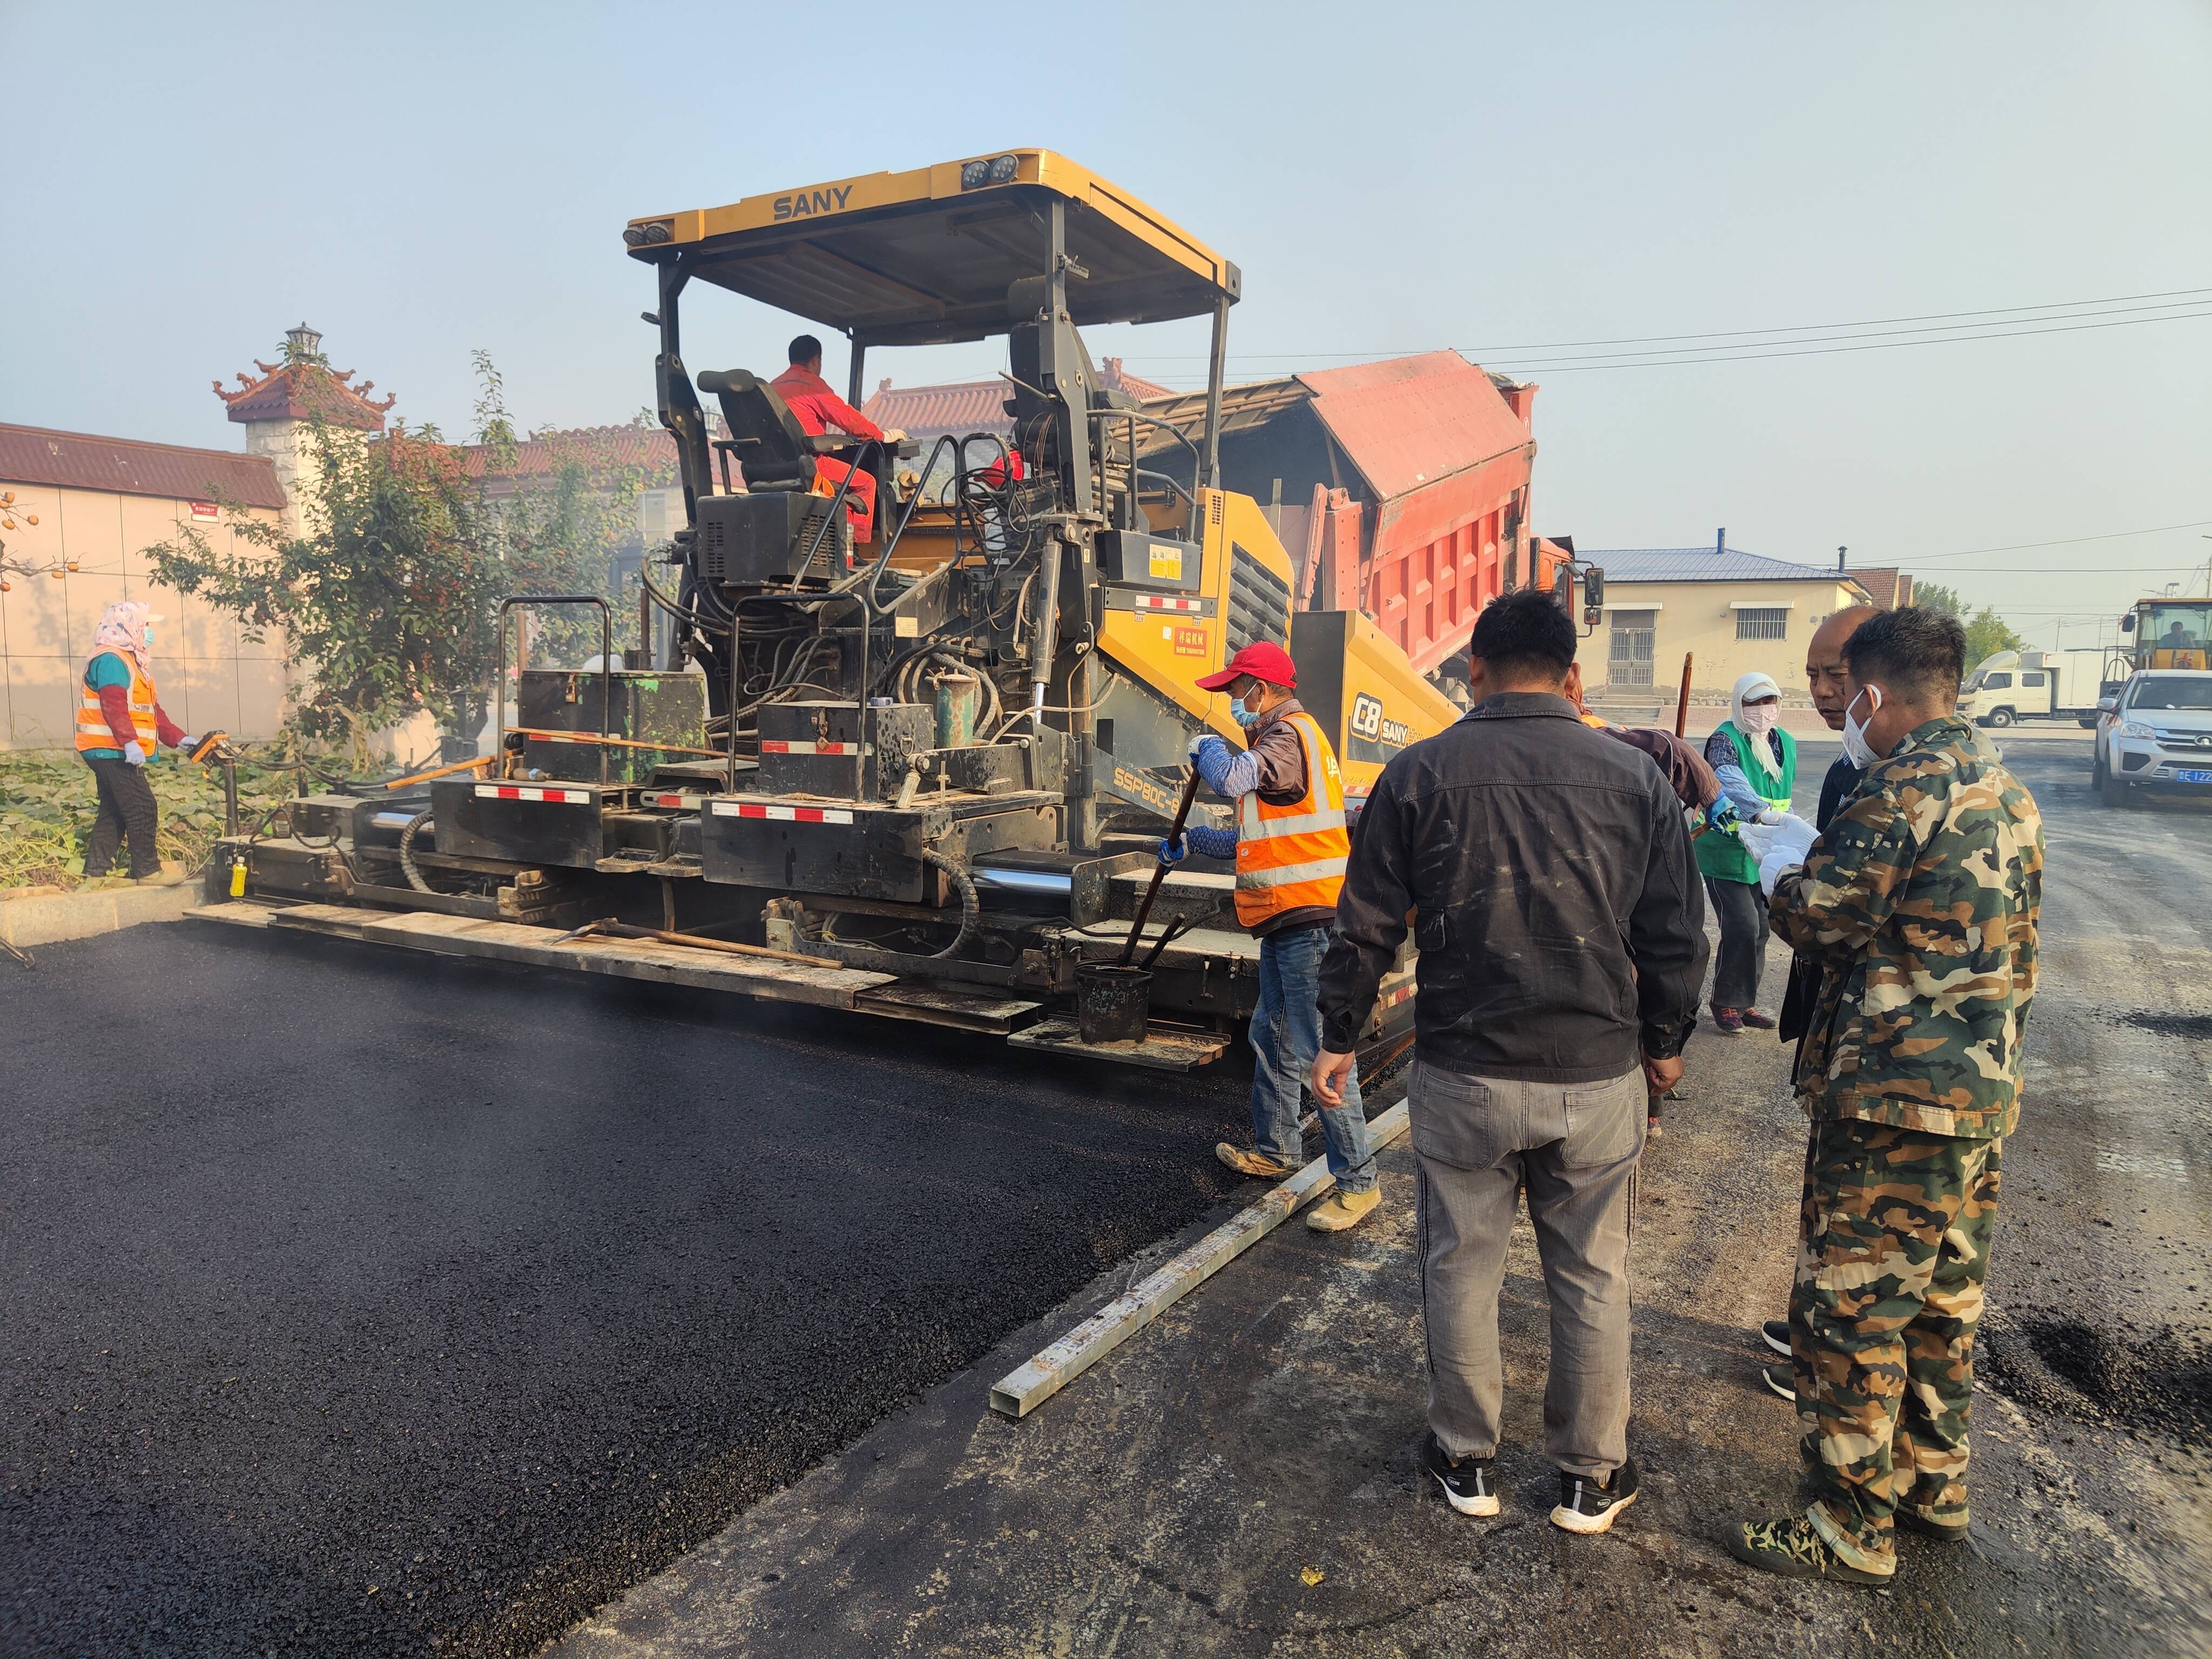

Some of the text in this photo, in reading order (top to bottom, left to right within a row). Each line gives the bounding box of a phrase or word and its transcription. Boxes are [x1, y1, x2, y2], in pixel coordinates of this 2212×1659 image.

[773, 185, 853, 221] SANY
[1179, 630, 1204, 645] 祥瑞机械
[1352, 696, 1408, 744] C8 SANY
[1114, 767, 1180, 815] SSP80C-8
